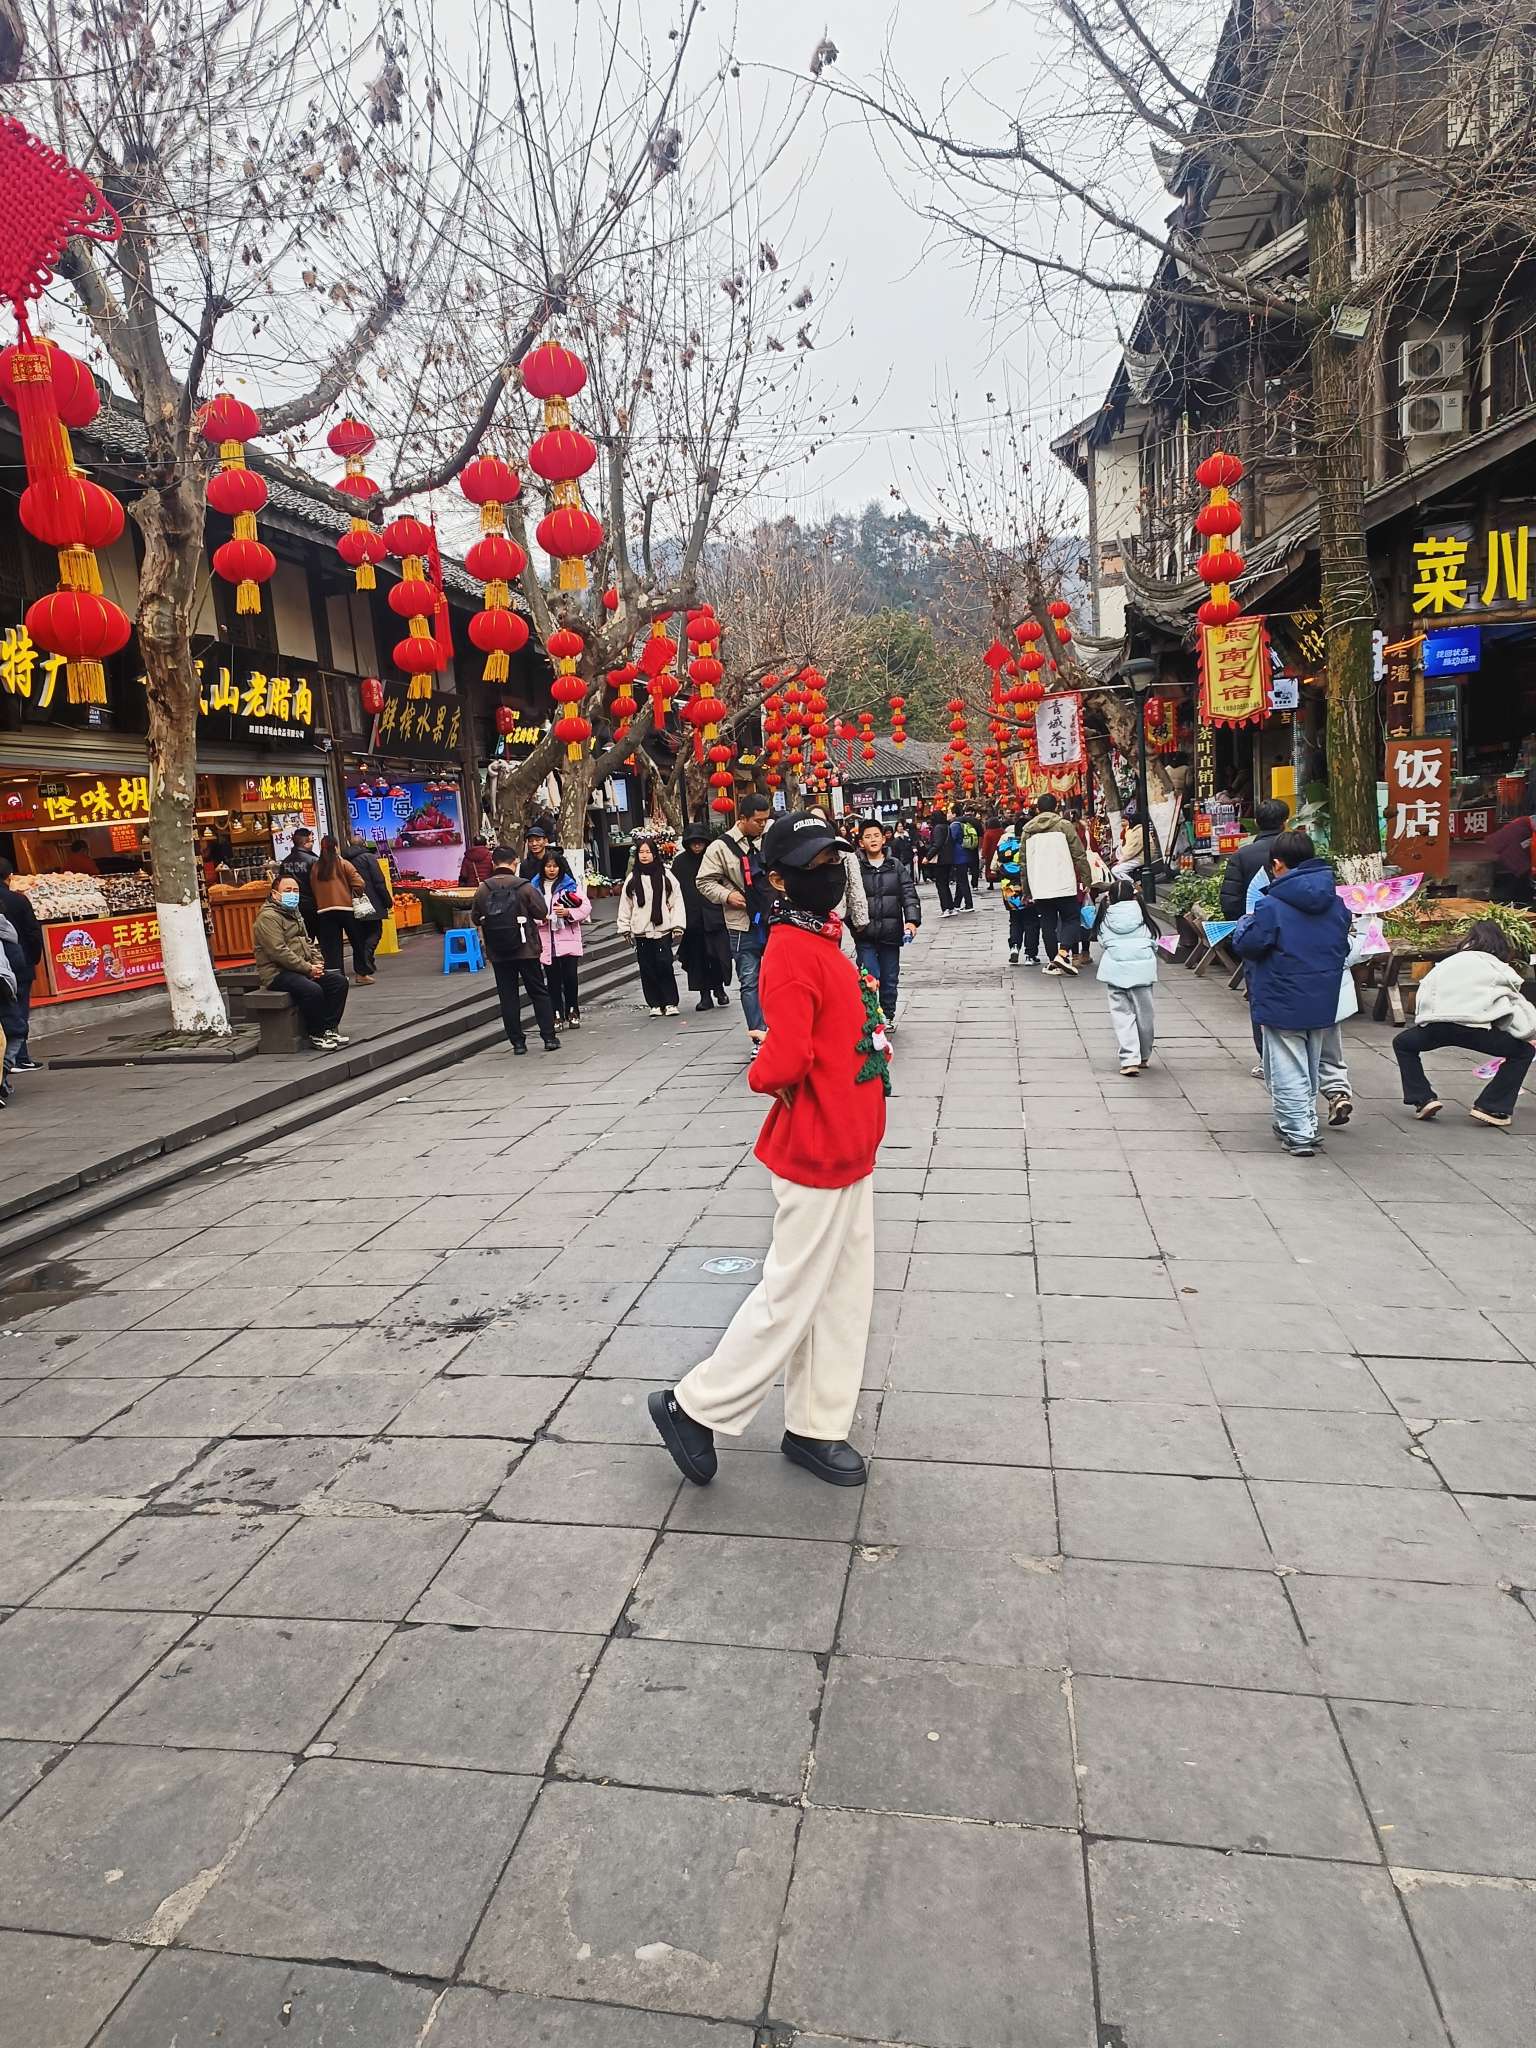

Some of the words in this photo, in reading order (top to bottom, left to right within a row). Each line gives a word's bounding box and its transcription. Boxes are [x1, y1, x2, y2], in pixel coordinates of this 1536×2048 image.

[1216, 628, 1254, 701] 燕南民宿
[1047, 699, 1067, 762] 青城茶叶
[1393, 748, 1443, 839] 饭店
